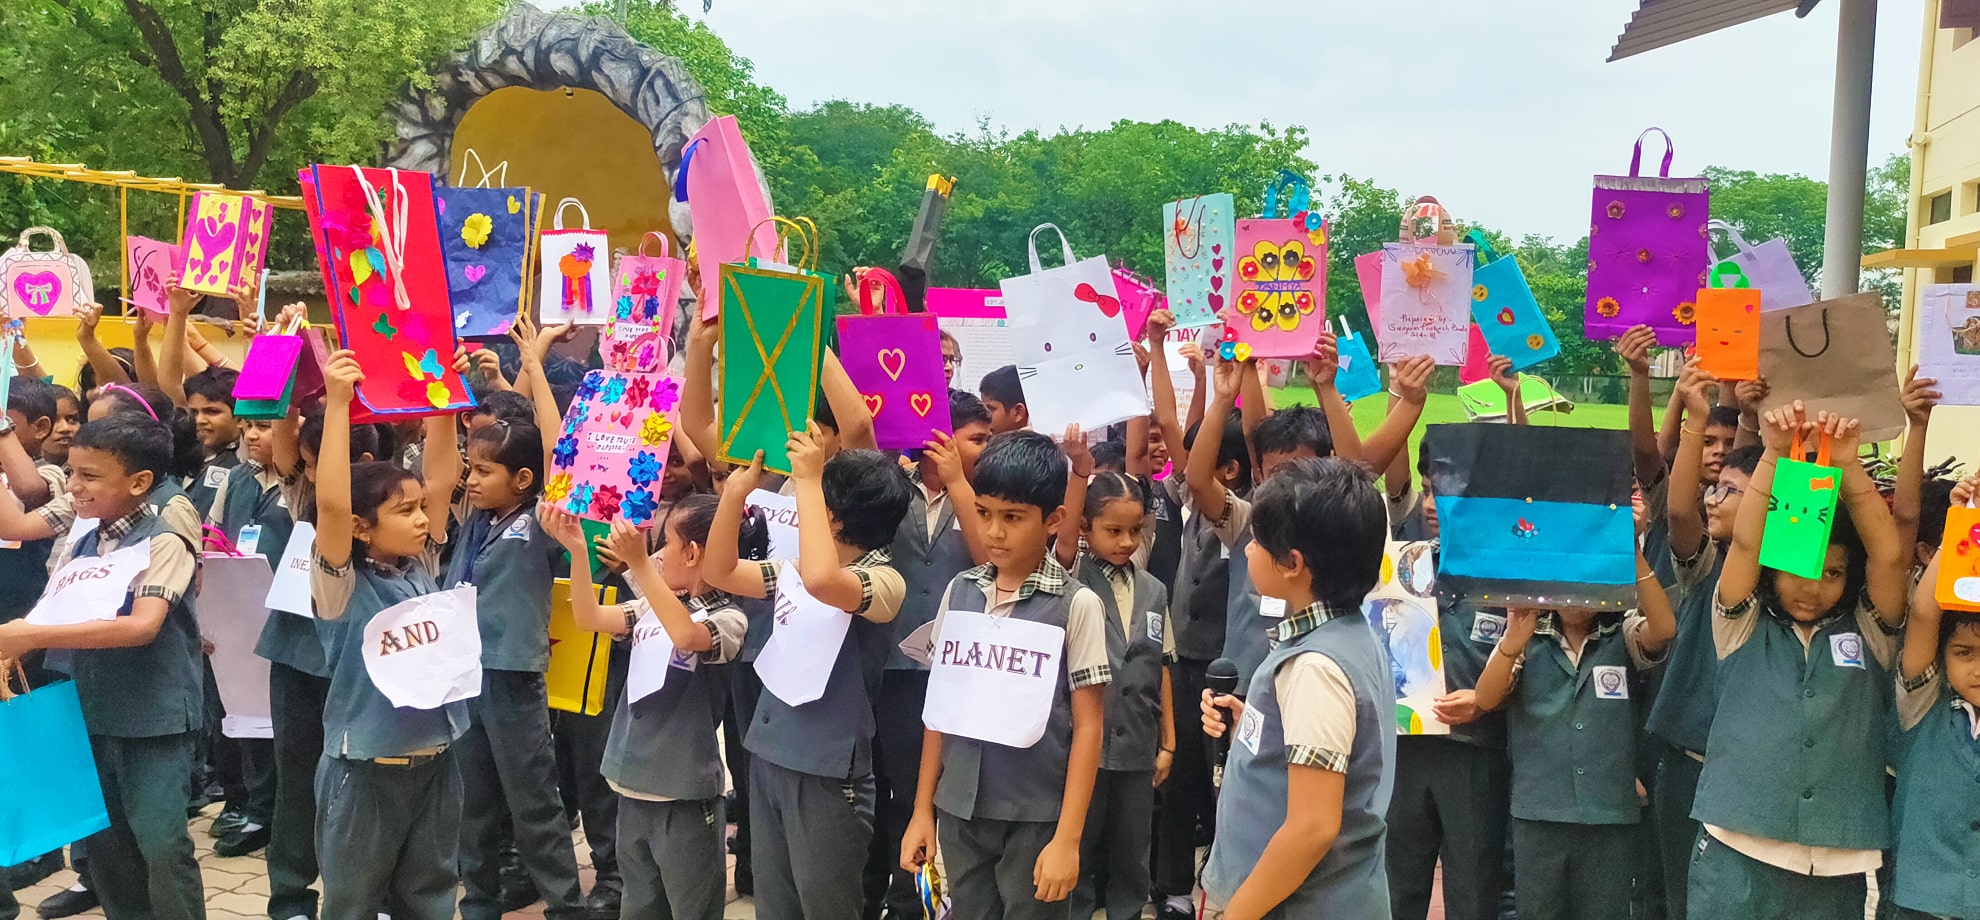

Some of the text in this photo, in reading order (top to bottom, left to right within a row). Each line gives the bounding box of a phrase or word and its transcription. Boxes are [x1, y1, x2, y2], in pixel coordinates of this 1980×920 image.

[594, 433, 615, 443] LOVE
[53, 563, 116, 597] BAGS
[380, 620, 440, 656] AND
[940, 640, 1052, 678] PLANET
